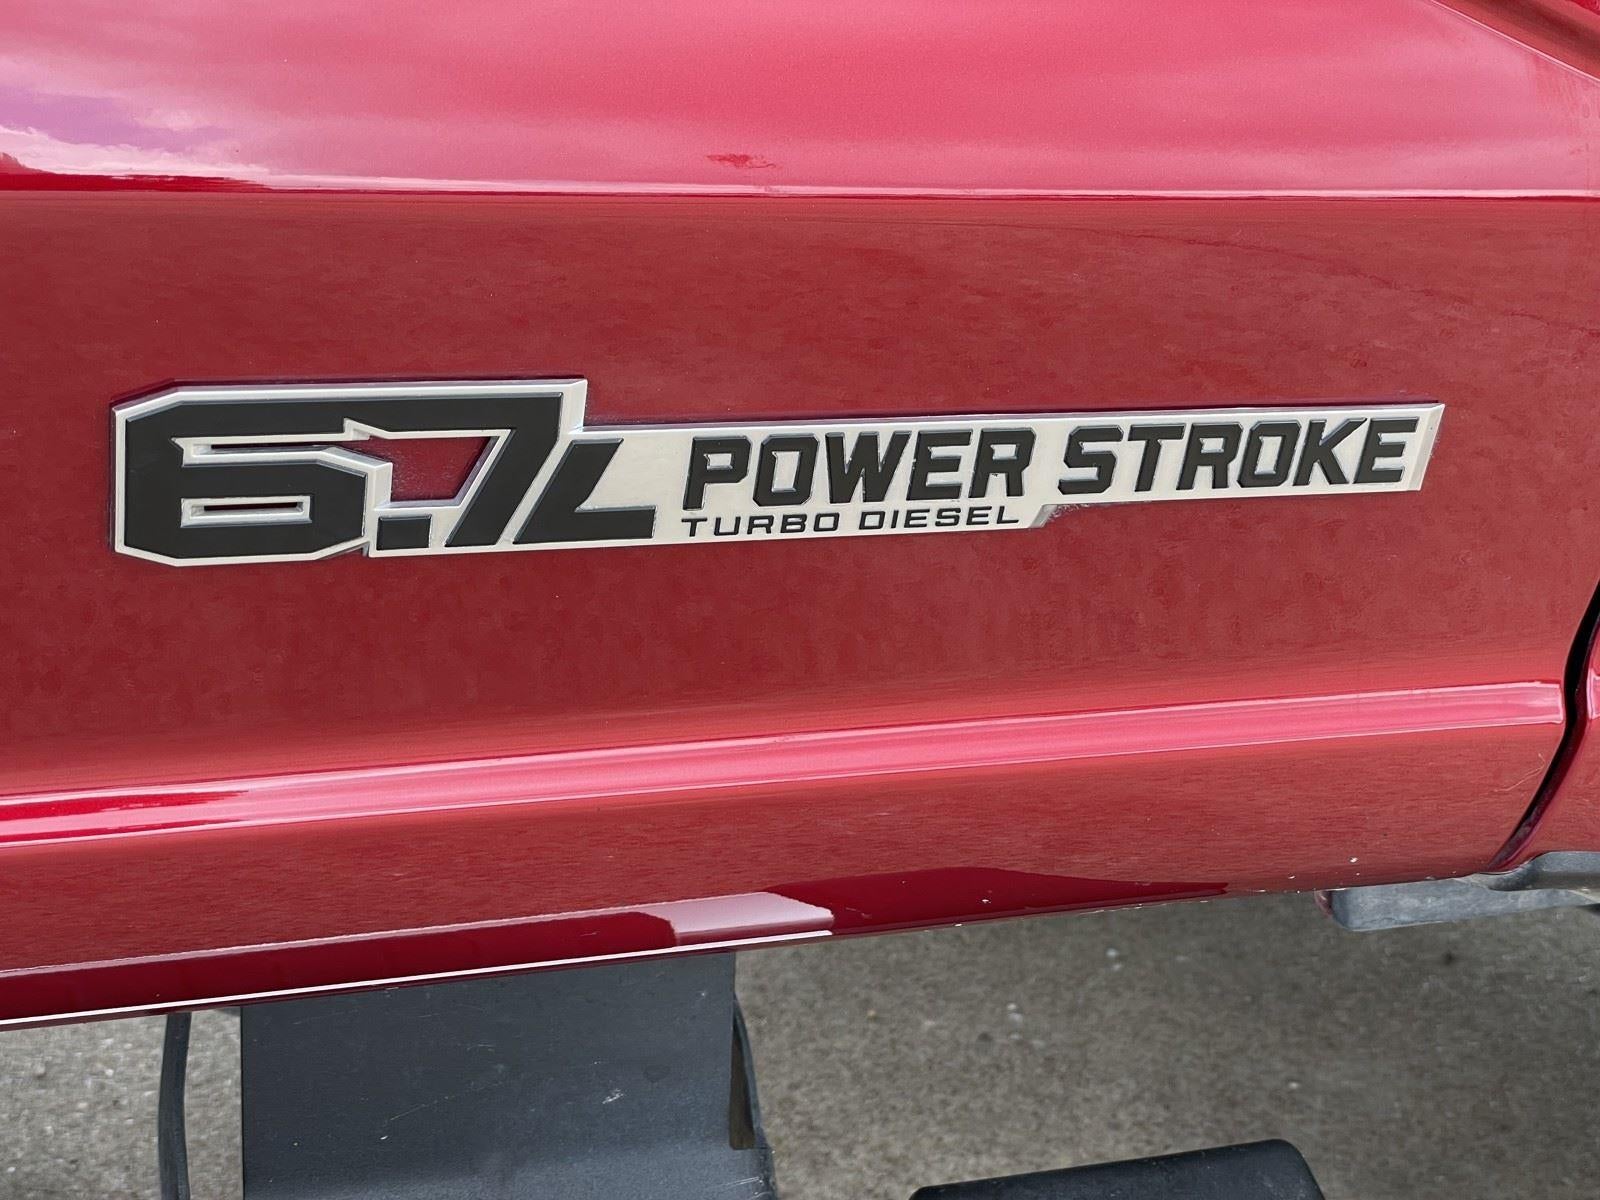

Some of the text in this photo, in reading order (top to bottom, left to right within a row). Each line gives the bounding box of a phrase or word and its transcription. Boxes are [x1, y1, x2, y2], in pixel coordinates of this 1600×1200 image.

[126, 392, 1420, 559] 6.7L POWER STROKE
[681, 506, 1019, 537] TURBO DIESEL
